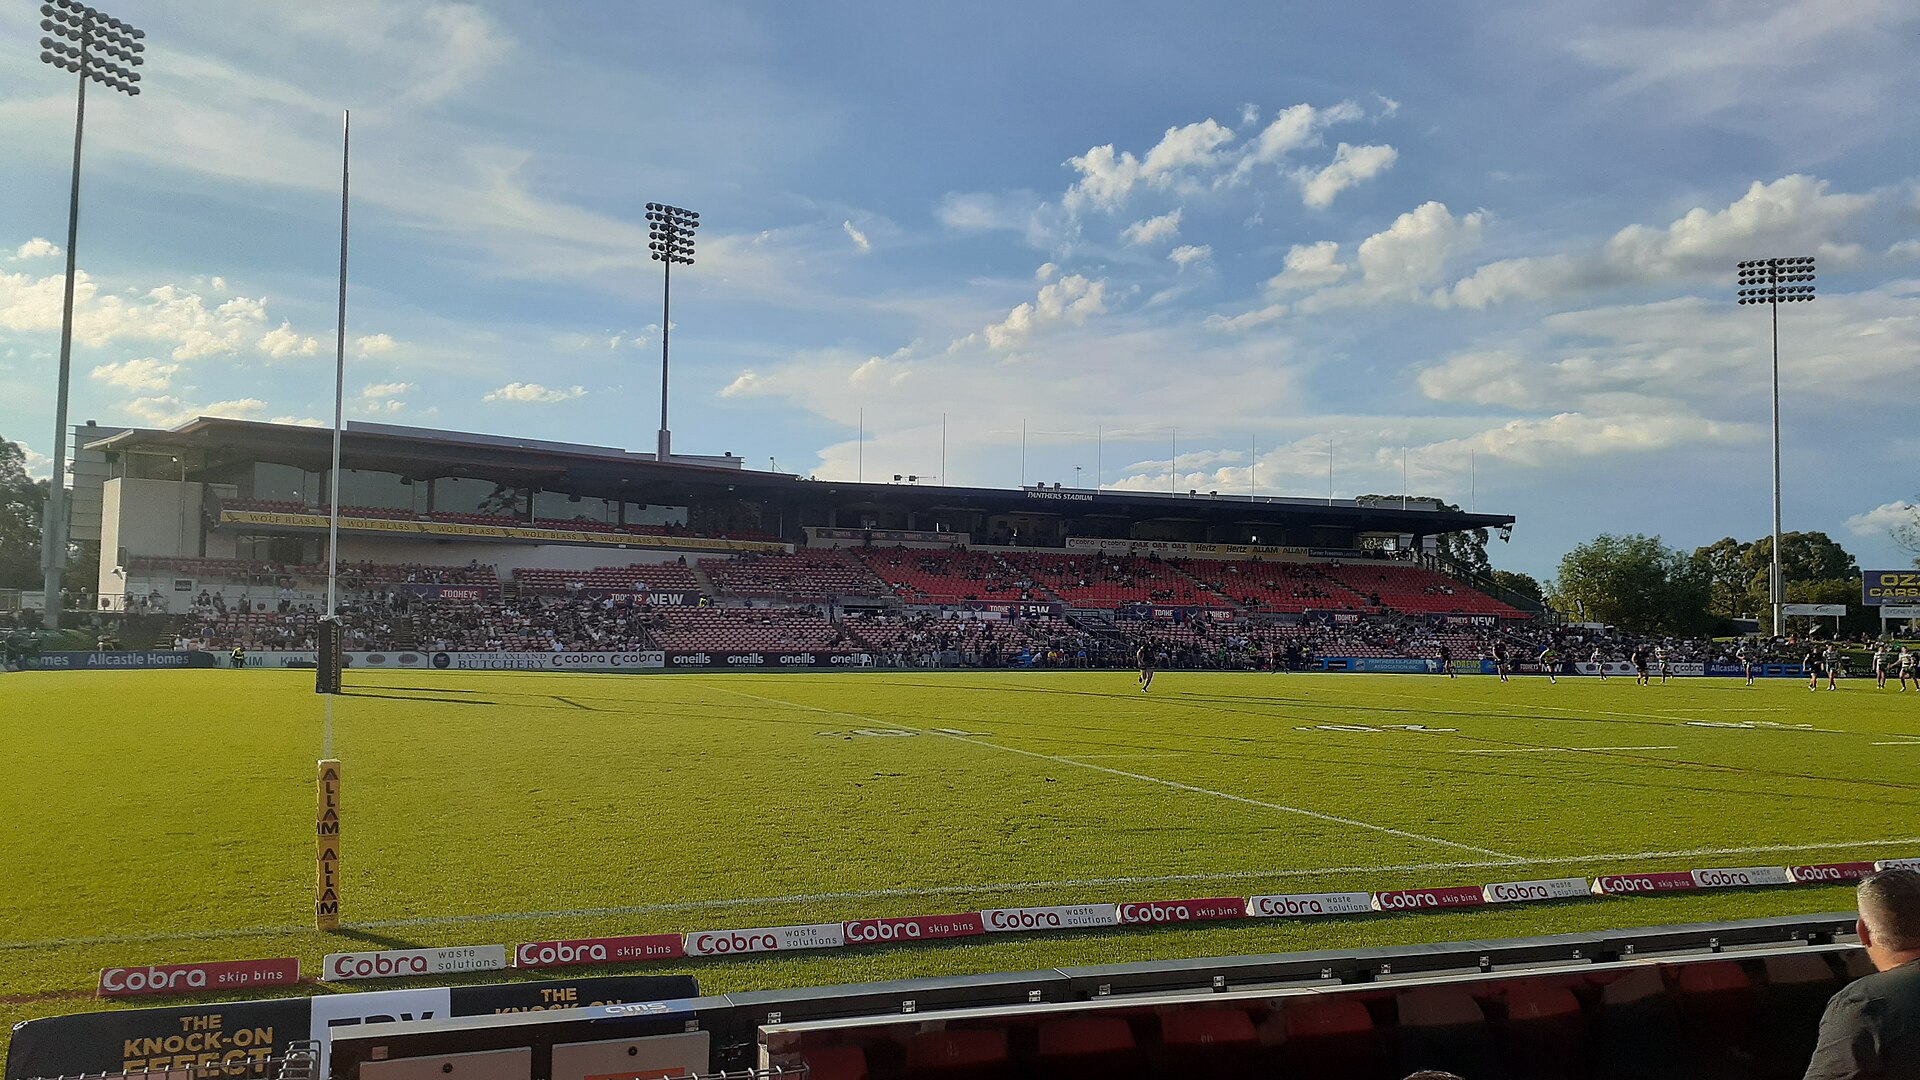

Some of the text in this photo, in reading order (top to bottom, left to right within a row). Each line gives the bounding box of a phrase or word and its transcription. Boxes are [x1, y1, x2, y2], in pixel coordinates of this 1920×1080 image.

[1028, 492, 1062, 500] PANTHERS
[250, 514, 317, 526] WOLF BLASS
[347, 520, 375, 528] WOLF
[1880, 574, 1920, 586] OZ
[441, 590, 479, 598] TOOHEYS
[649, 593, 684, 604] NEW
[1869, 588, 1920, 597] CARS
[1335, 613, 1358, 622] TOOHEYS
[1470, 616, 1495, 626] NEW
[40, 653, 189, 666] mes Allcastle Homes
[565, 653, 605, 663] cobra
[623, 653, 662, 662] cobra
[458, 660, 546, 669] BUTCHERY
[1700, 871, 1750, 885] Cobra
[1794, 866, 1841, 880] Cobra
[1600, 876, 1690, 892] Cobra skip bins
[1494, 884, 1548, 900] Cobra
[1552, 887, 1589, 895] solutions
[1260, 897, 1322, 915] Cobra
[1380, 892, 1477, 909] Cobra skip bins
[1066, 907, 1094, 916] waste
[1328, 902, 1369, 912] solutions
[991, 910, 1060, 929] Cobra
[1068, 915, 1112, 924] solutions
[1123, 904, 1237, 923] Cobra skip bins
[785, 928, 817, 937] waste
[847, 920, 974, 942] Cobra skip bins
[696, 933, 777, 954] Cobra
[786, 936, 837, 947] solutions
[438, 949, 475, 959] waste
[519, 942, 671, 964] Cobra skip bins
[335, 953, 427, 977] Cobra
[438, 958, 498, 970] solutions
[102, 967, 283, 992] Cobra skip bins
[540, 988, 577, 1003] THE
[605, 1002, 667, 1013] cms
[180, 1014, 222, 1032] THE
[124, 1026, 273, 1058] KNOCK-ON
